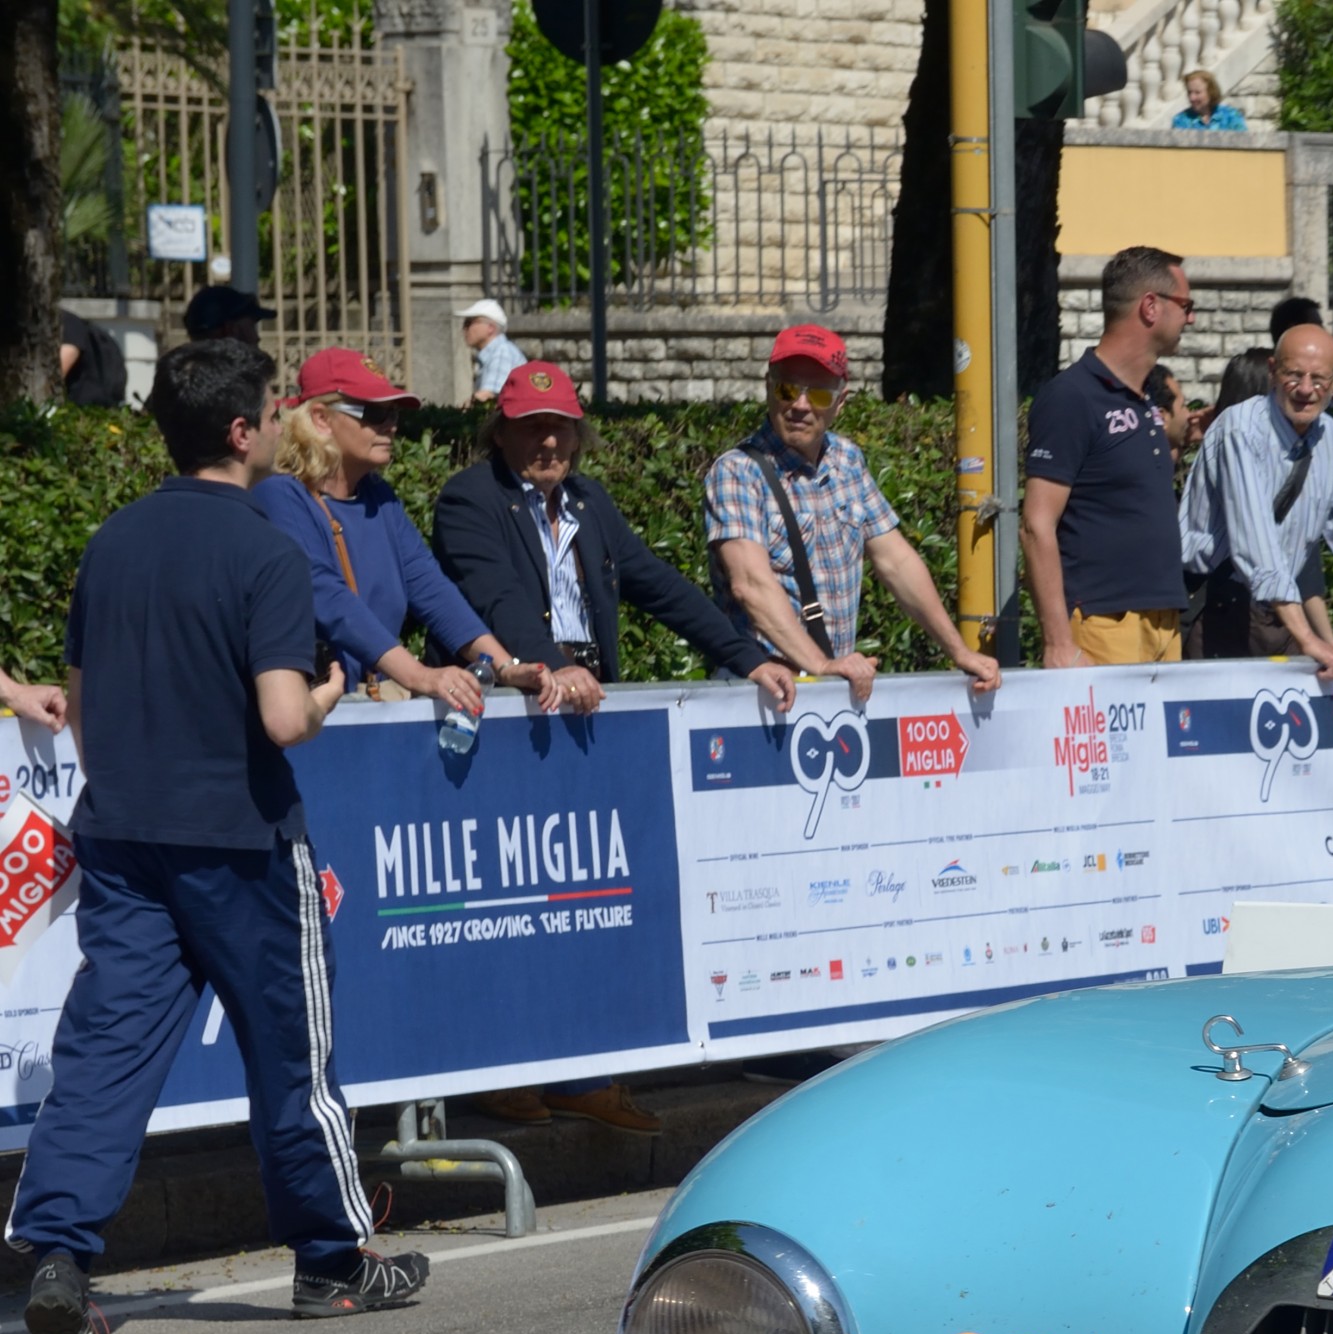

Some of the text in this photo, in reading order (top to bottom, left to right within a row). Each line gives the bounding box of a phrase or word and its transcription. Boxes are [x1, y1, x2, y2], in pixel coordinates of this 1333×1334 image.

[471, 18, 488, 36] 25
[1064, 685, 1146, 735] Mille 2017
[906, 720, 950, 742] 1000
[905, 749, 956, 772] MIGLIA
[1054, 735, 1108, 797] Miglia
[16, 763, 77, 799] 2017
[1091, 767, 1110, 780] 18-21
[375, 808, 630, 898] MILLE MIGLIA
[1083, 855, 1097, 868] JCL
[1030, 859, 1060, 873] Alitalia
[809, 879, 850, 889] KIENLE
[931, 875, 977, 889] VREDESTEIN
[719, 887, 780, 902] VILLA TRASQUA
[381, 924, 426, 950] SINCE
[429, 920, 462, 945] 1927
[540, 909, 571, 934] THE
[575, 904, 633, 932] FUTURE
[1203, 919, 1221, 935] UBI
